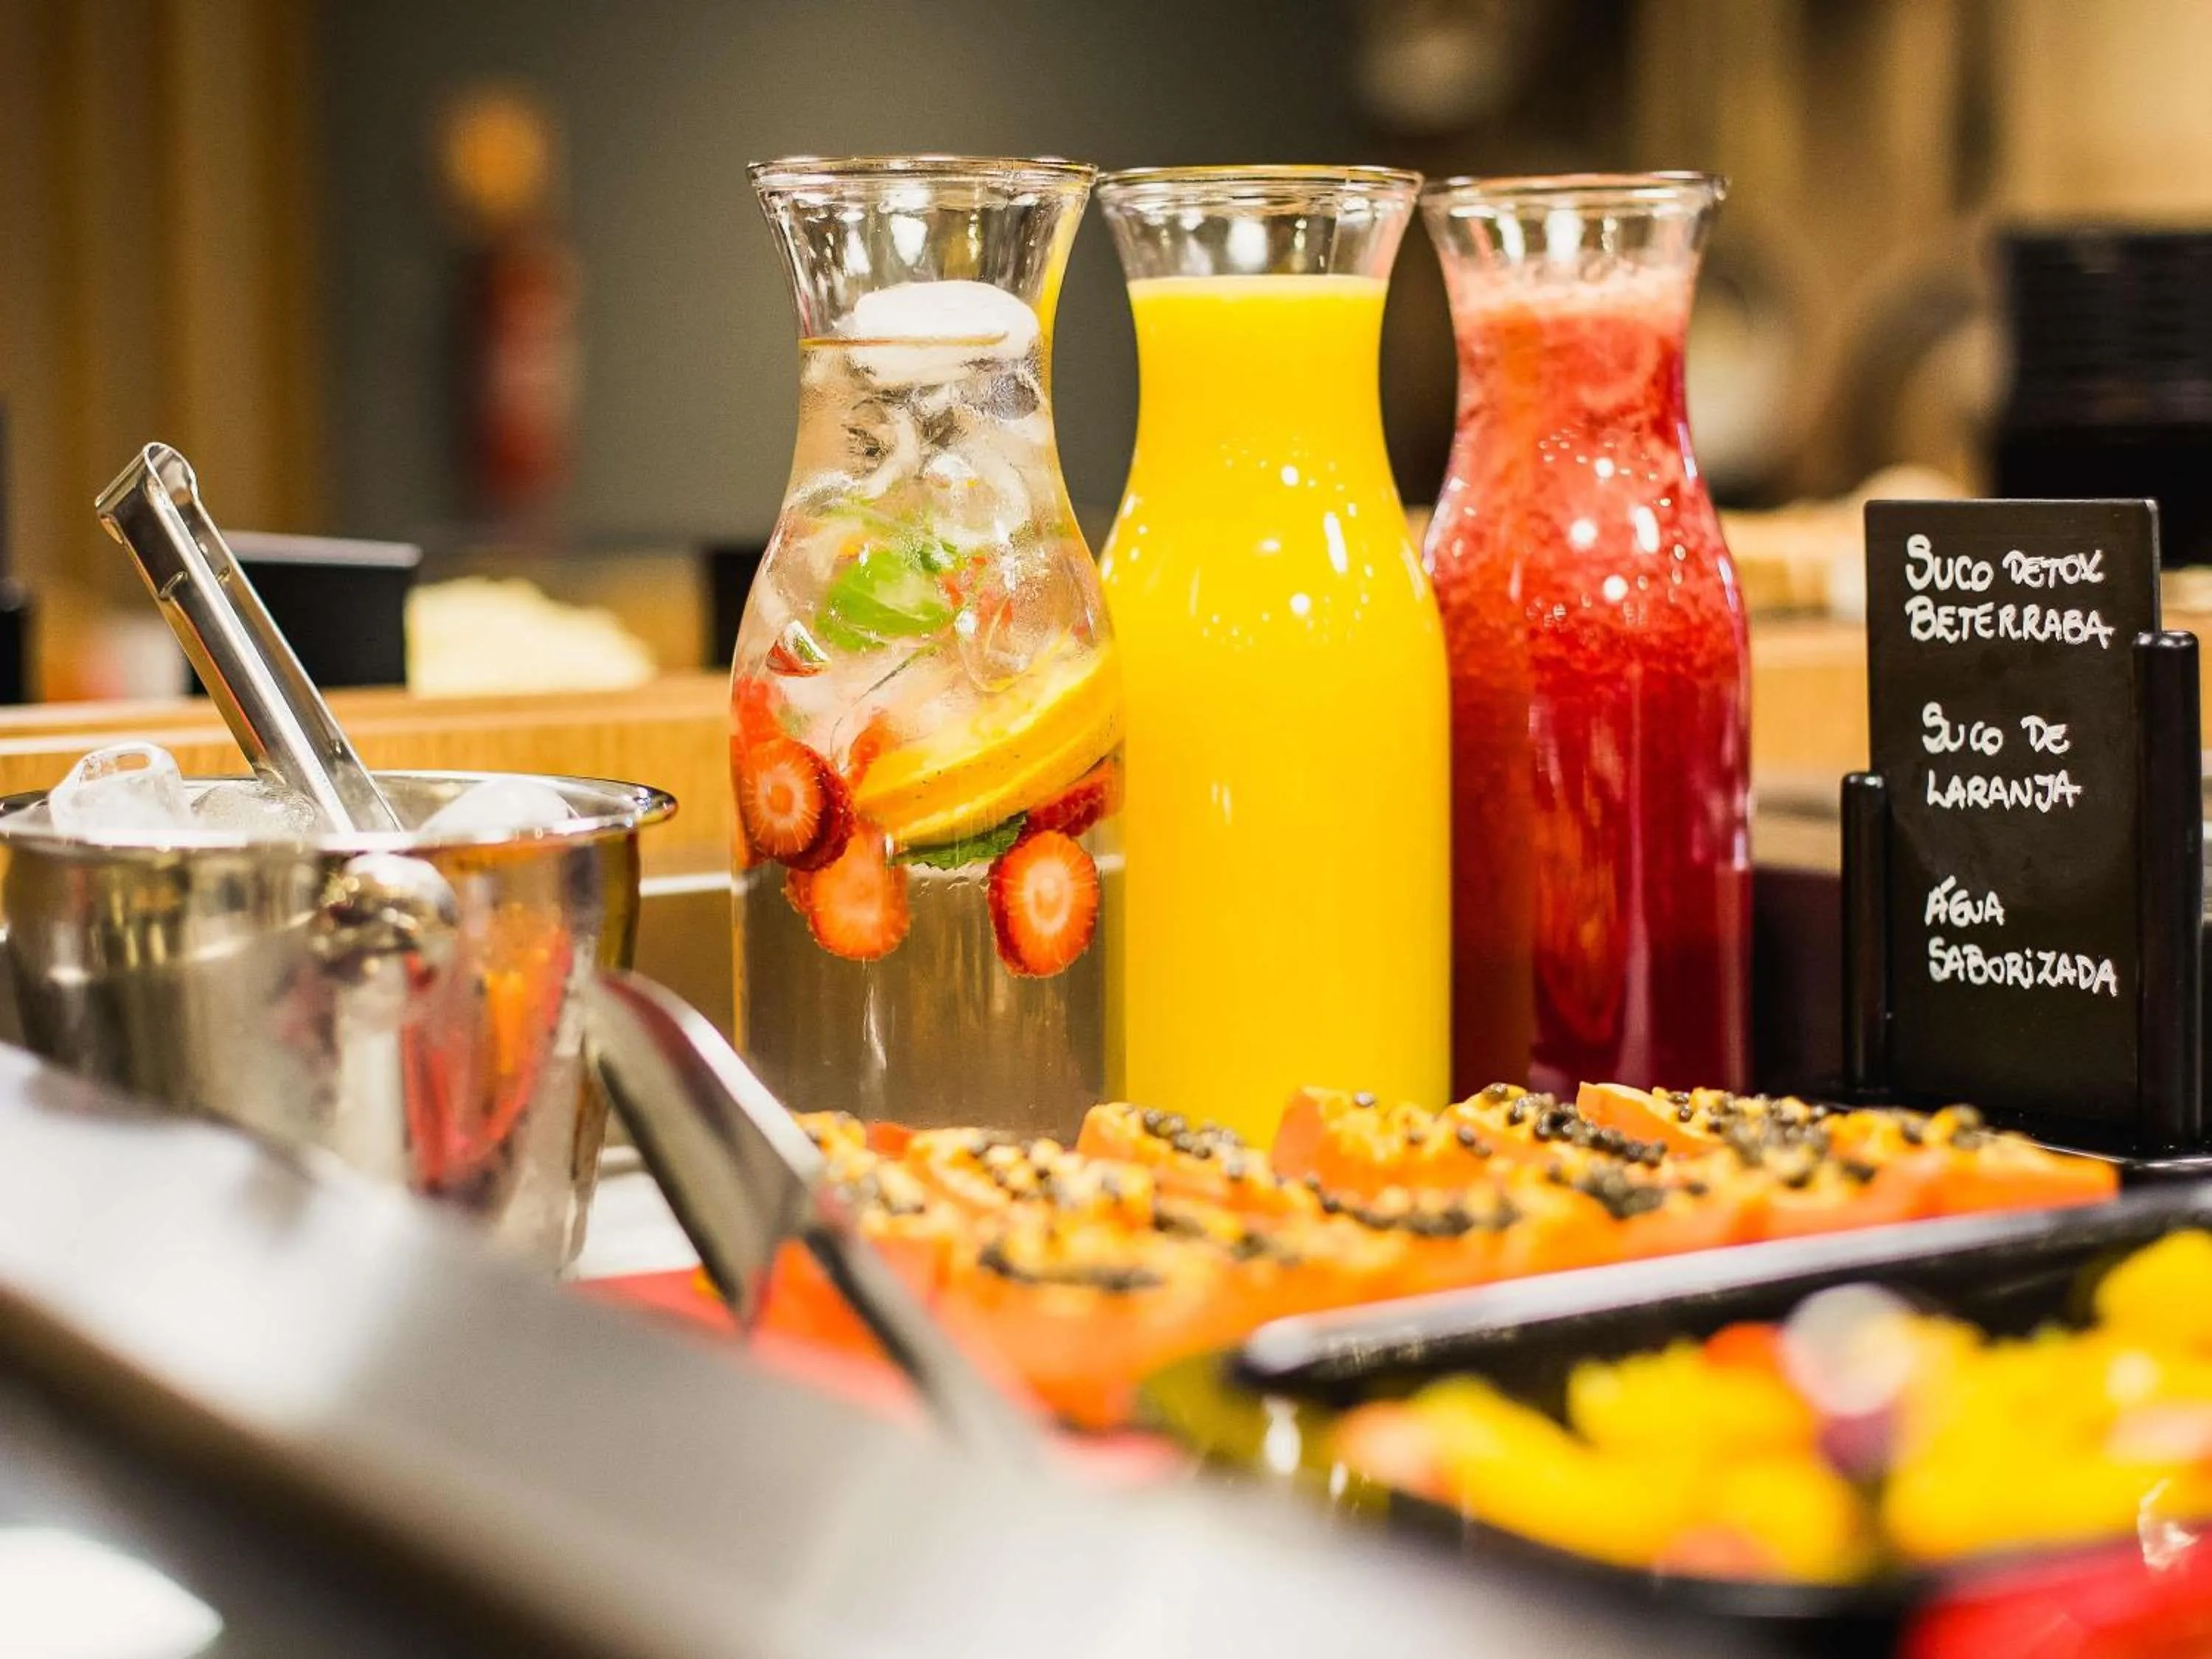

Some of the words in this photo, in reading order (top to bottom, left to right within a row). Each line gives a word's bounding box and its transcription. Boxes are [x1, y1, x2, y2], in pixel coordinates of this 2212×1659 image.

[1905, 534, 1994, 592] SUCO
[2002, 549, 2104, 589] DETOX
[1905, 595, 2115, 650] BETERRABA
[1922, 702, 2003, 756] SUCO
[2020, 714, 2070, 754] DE
[1927, 769, 2082, 813] LARANJA
[1924, 875, 2005, 928] ÁGUA
